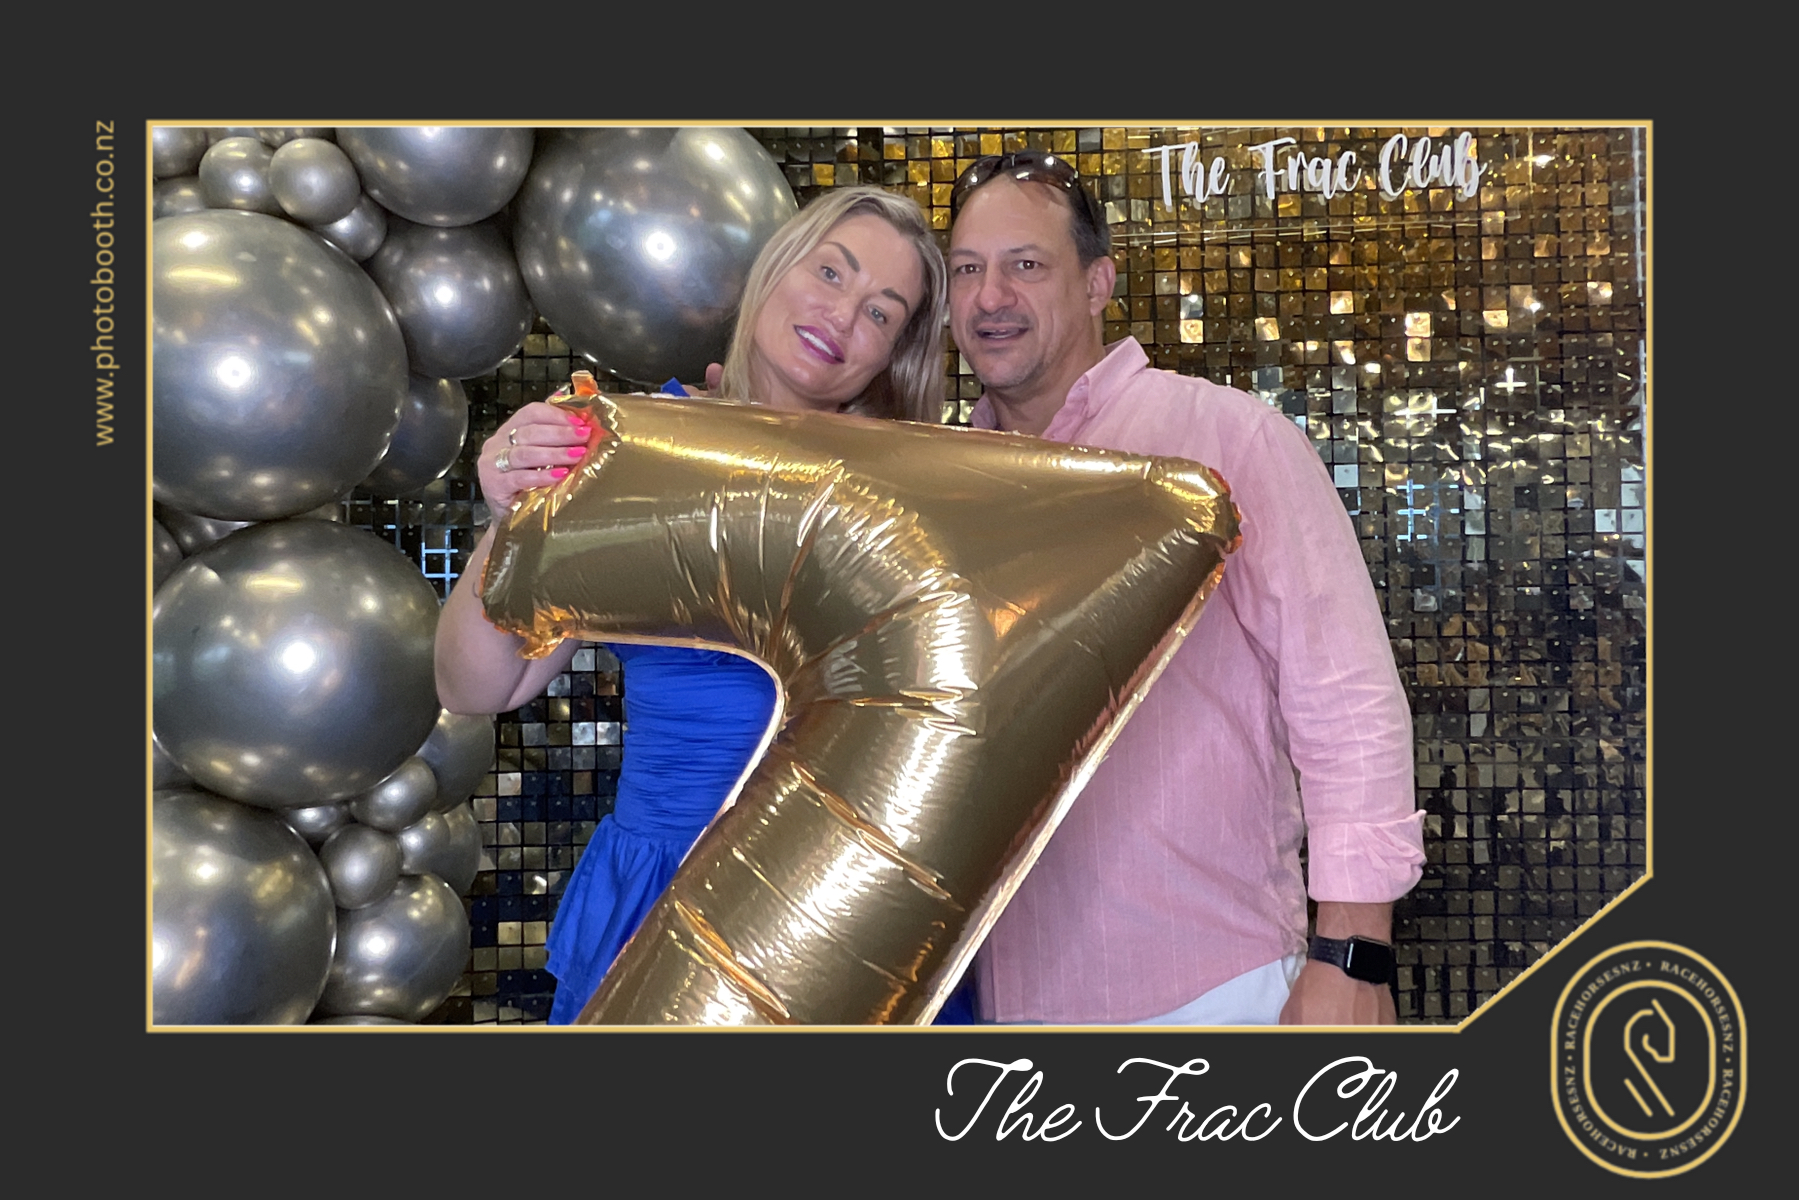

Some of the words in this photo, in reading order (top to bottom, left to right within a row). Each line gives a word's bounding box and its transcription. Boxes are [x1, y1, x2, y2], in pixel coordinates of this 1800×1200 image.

[1141, 140, 1231, 208] The
[1248, 136, 1363, 200] Frac
[1378, 131, 1488, 198] Club
